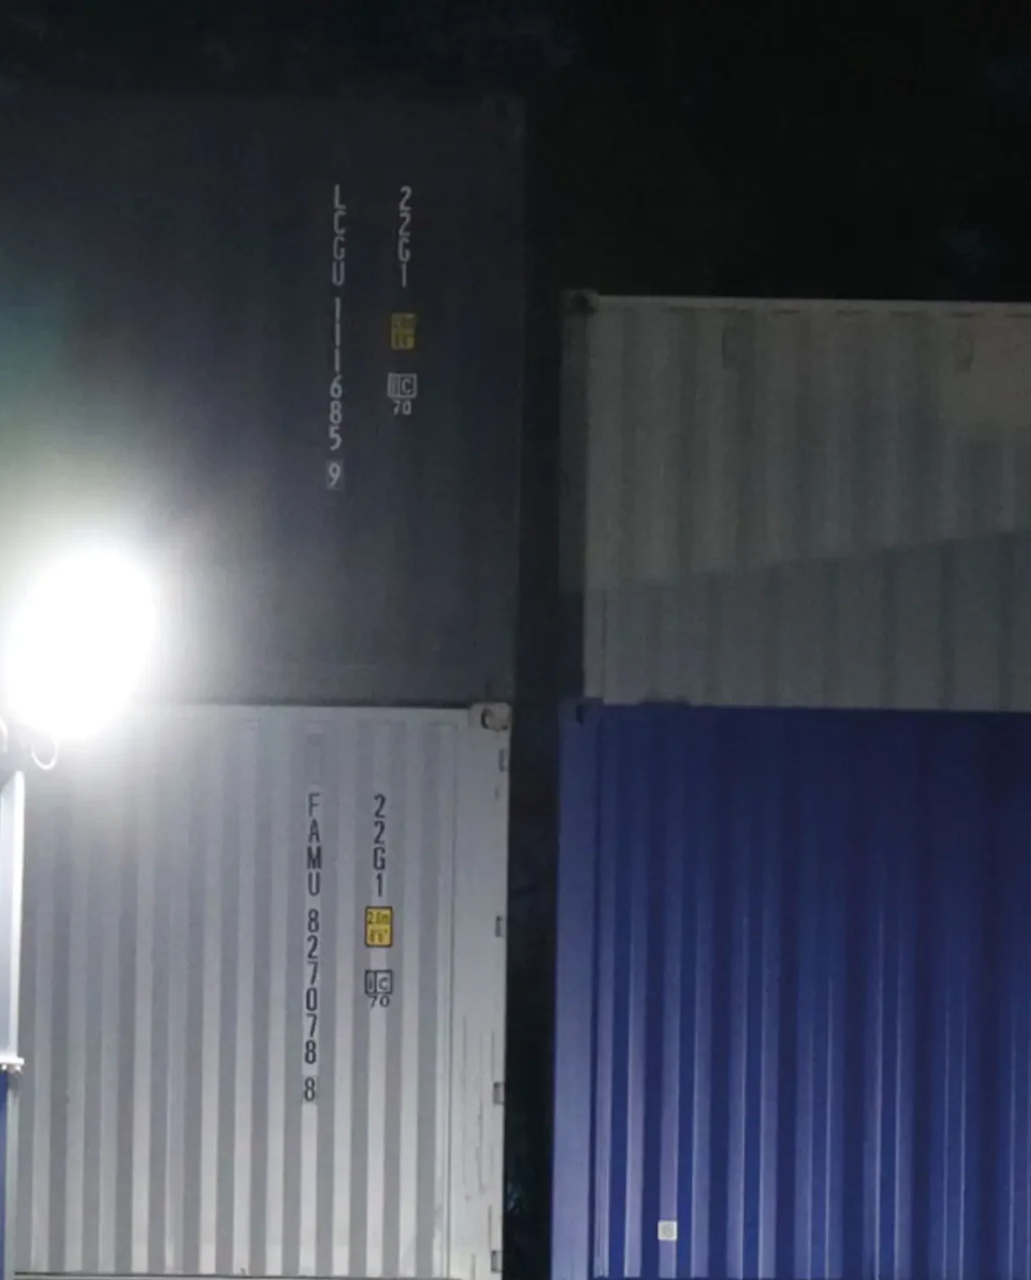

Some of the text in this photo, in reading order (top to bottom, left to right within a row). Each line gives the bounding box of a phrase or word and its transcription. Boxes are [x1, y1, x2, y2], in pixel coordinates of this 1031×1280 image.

[398, 185, 412, 287] 22G1
[327, 184, 346, 489] LCGU 111685 9
[393, 400, 412, 416] 70
[373, 793, 387, 897] 22G1
[303, 792, 322, 1102] FAMU 827078 8
[370, 995, 390, 1008] 70
